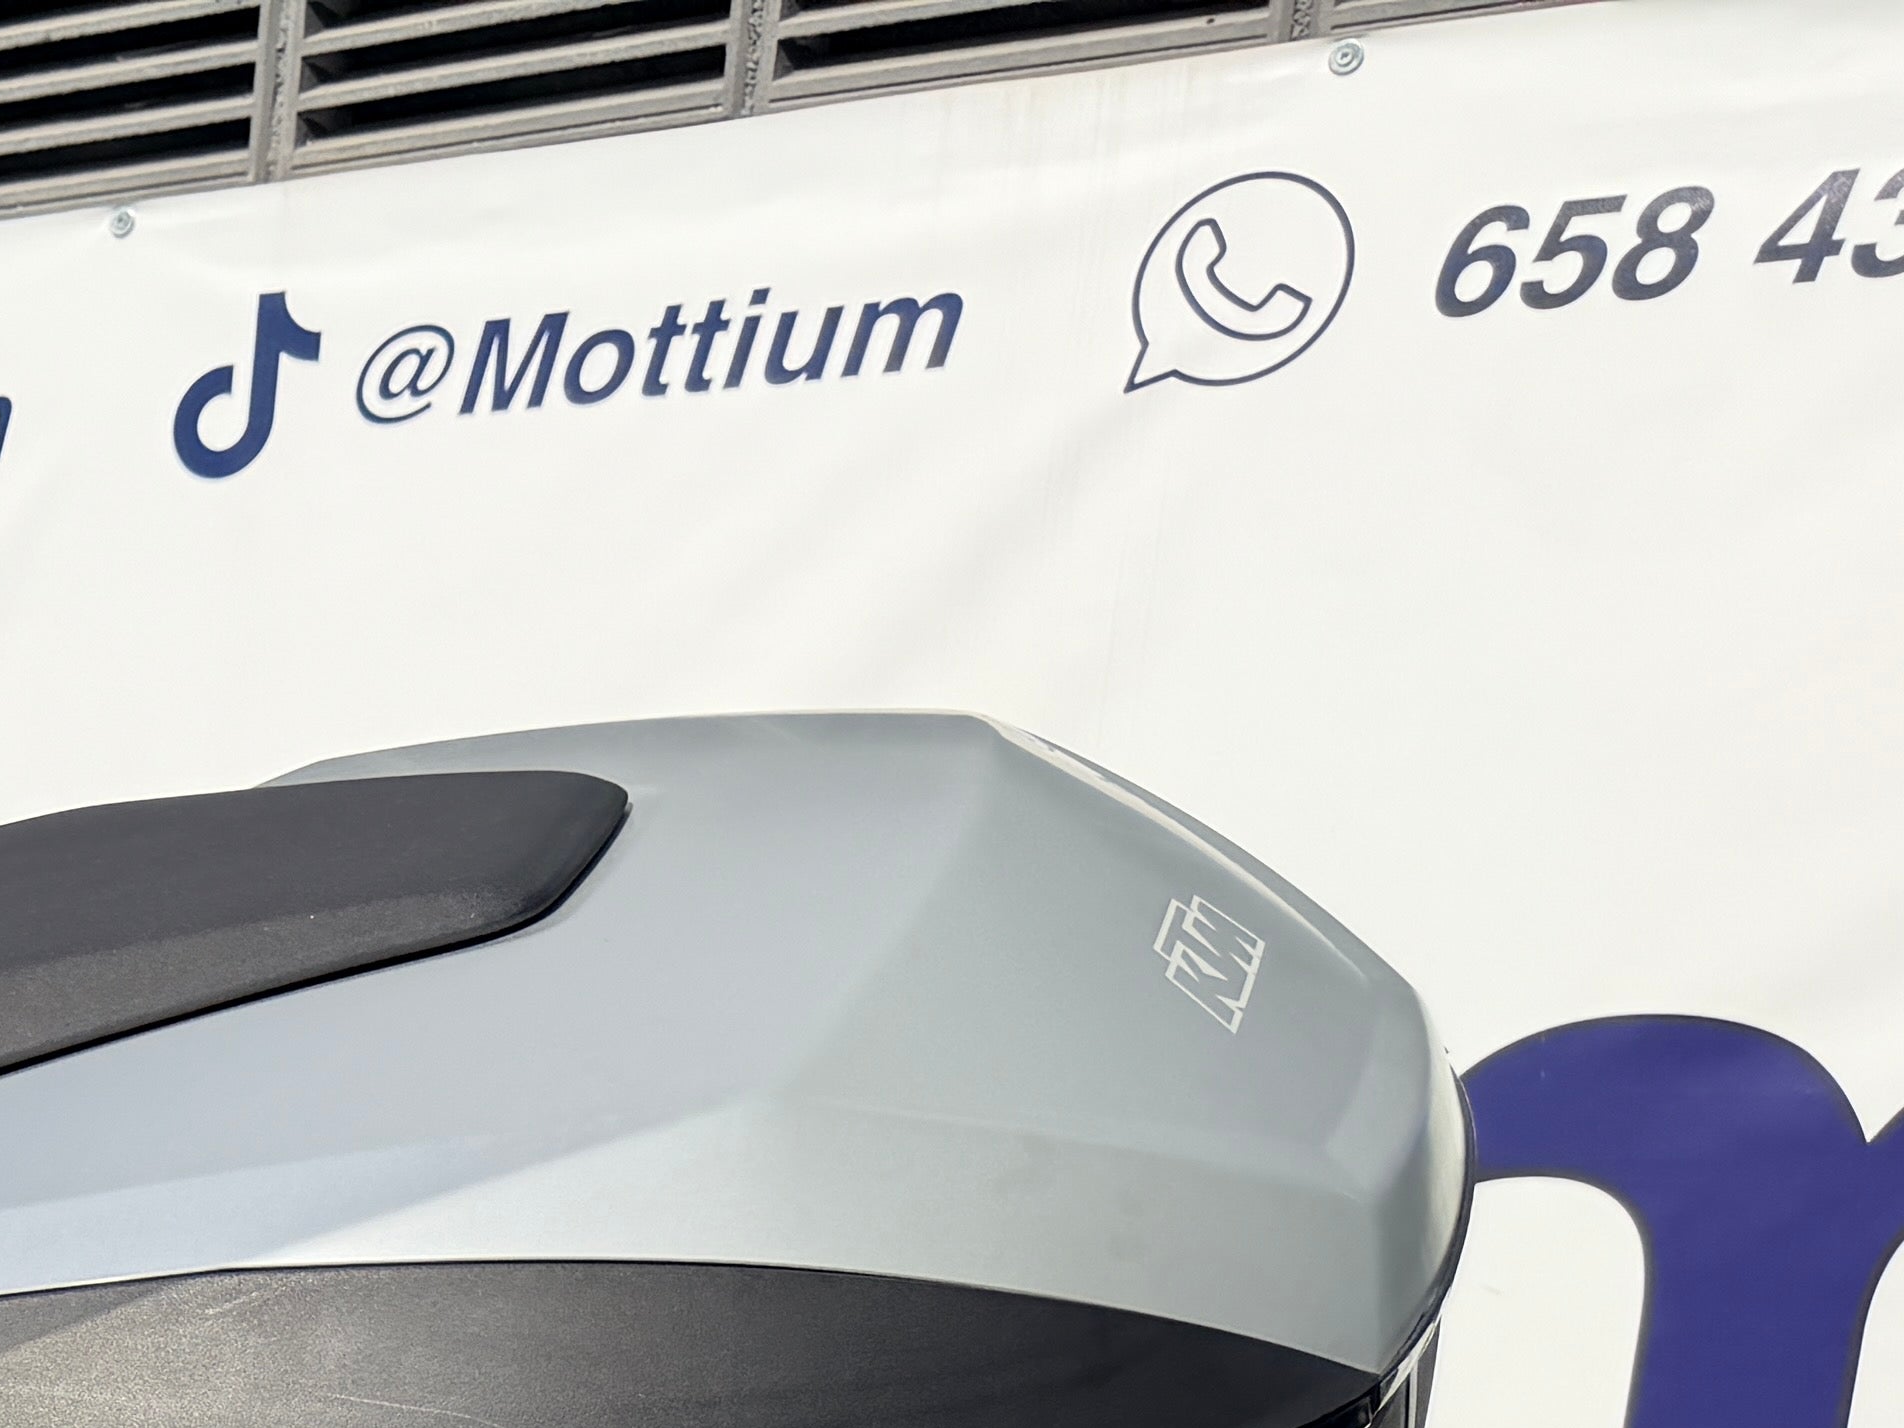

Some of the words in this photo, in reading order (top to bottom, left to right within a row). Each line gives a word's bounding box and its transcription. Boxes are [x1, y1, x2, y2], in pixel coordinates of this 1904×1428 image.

[1436, 187, 1714, 317] 658
[356, 288, 963, 424] @Mottium
[1153, 895, 1265, 1034] KTM
